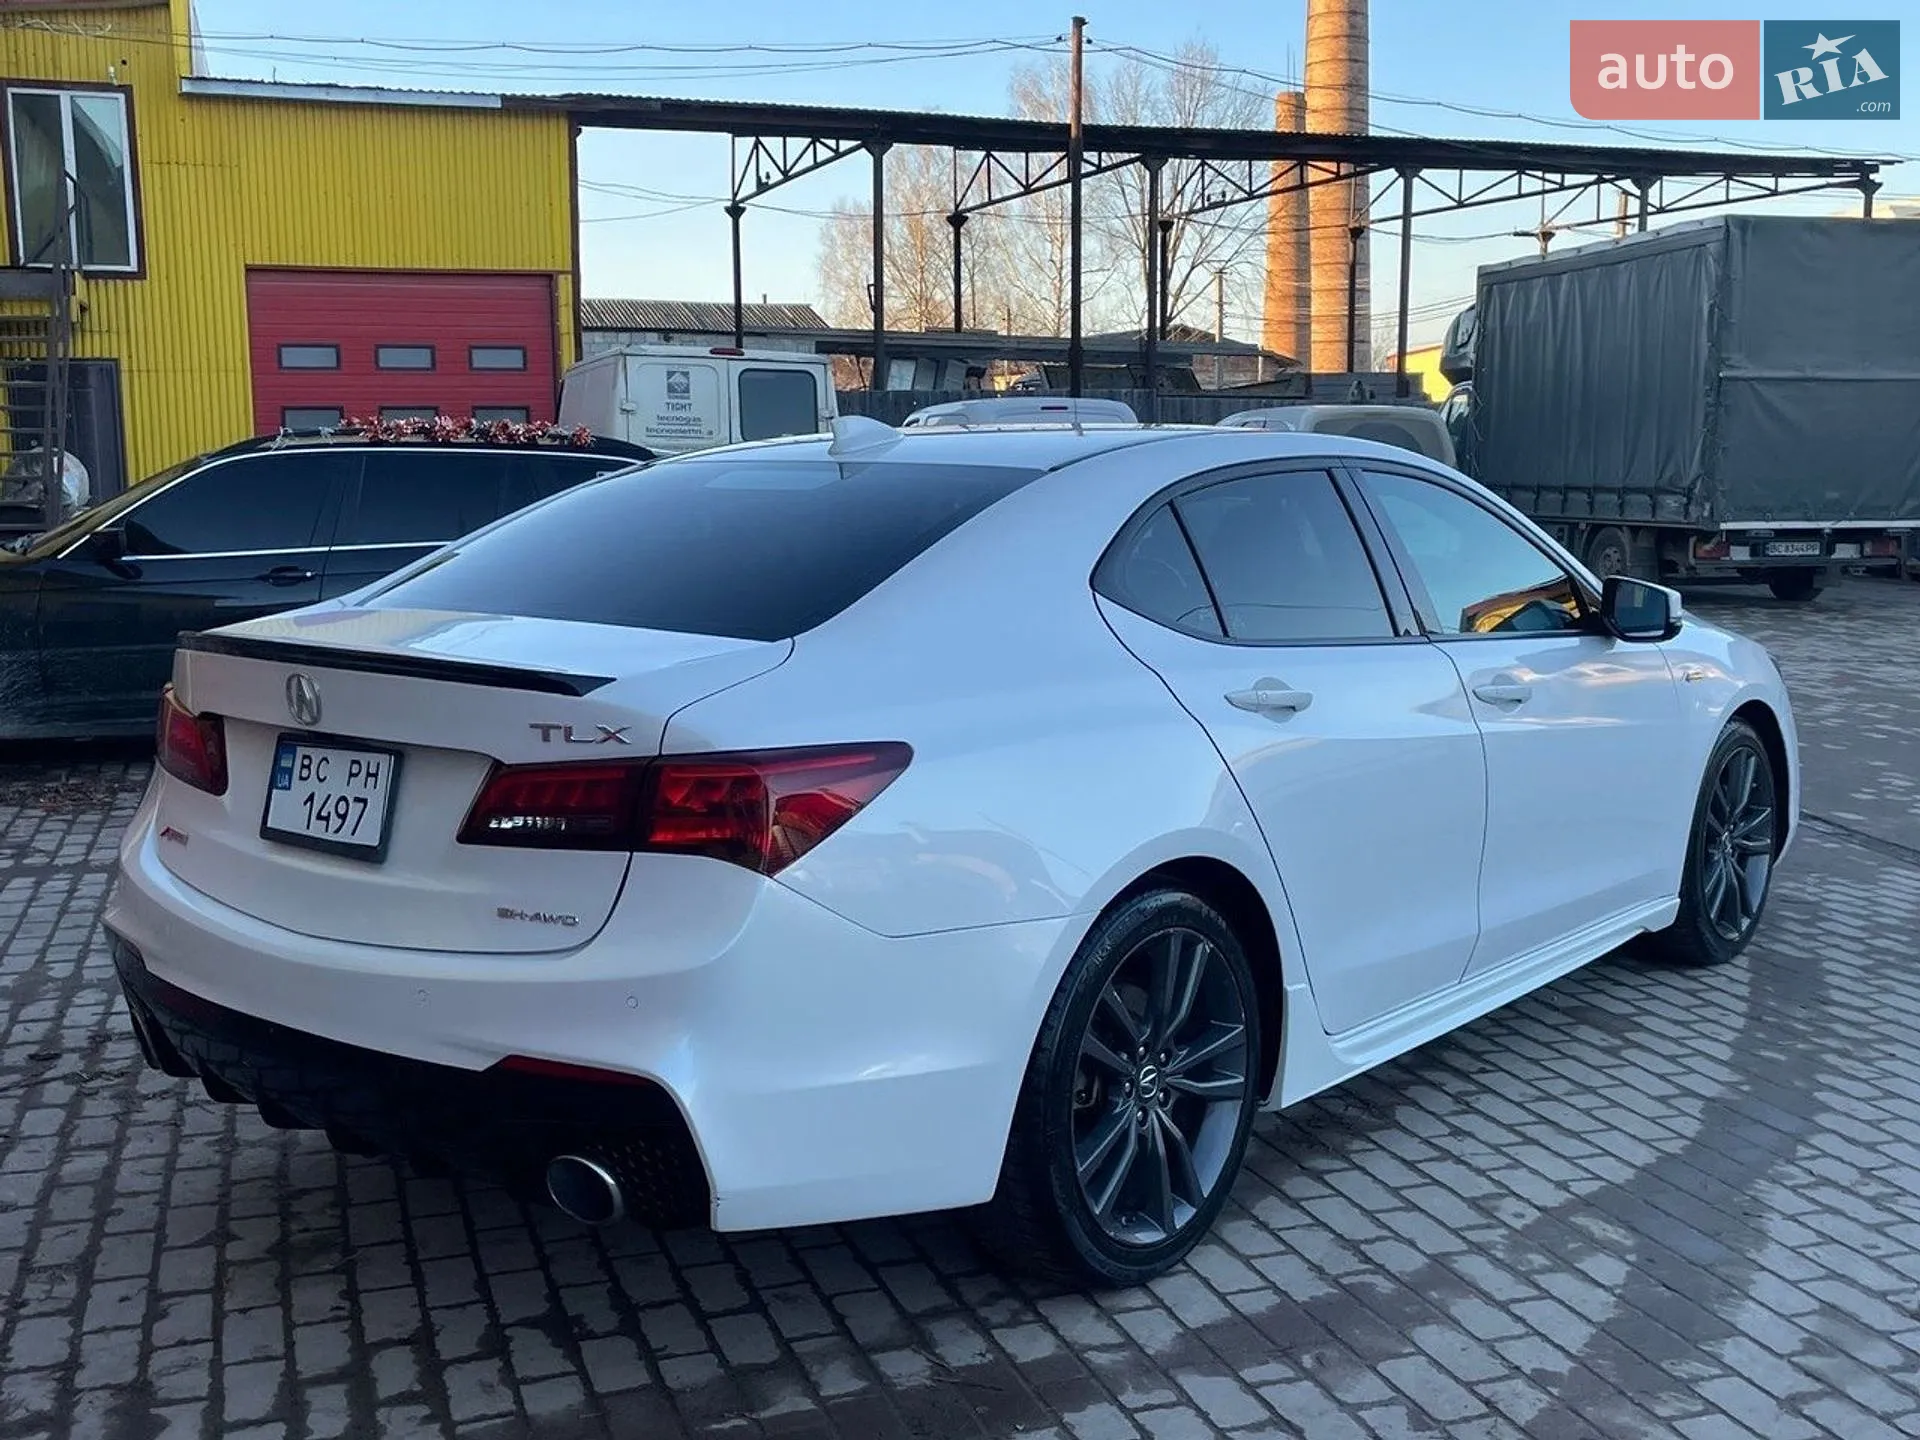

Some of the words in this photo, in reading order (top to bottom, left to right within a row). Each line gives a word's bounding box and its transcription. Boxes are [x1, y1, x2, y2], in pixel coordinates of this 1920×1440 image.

[528, 722, 632, 745] TLX
[298, 754, 330, 783] BC
[346, 759, 380, 790] PH
[303, 791, 369, 836] 1497
